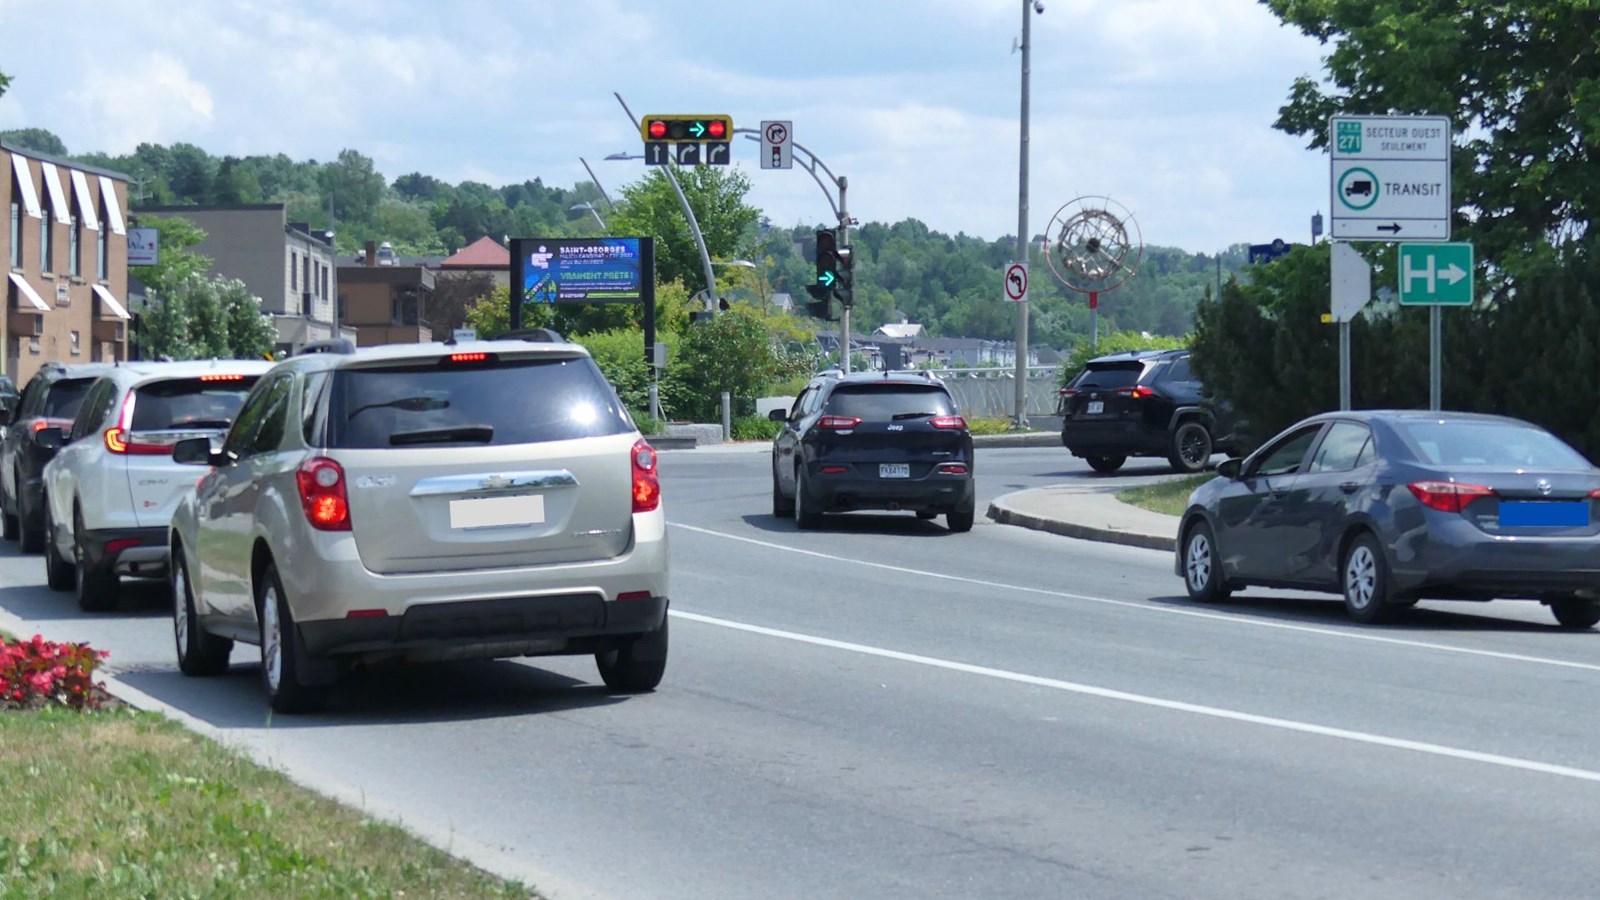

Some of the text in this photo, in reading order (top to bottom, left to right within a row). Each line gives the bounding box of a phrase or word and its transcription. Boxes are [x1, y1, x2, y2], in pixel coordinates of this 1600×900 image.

[1366, 127, 1441, 138] SECTEUR OUEST
[1339, 135, 1361, 149] 271
[1381, 142, 1427, 151] SEULEMENT
[1384, 182, 1442, 196] TRANSIT
[560, 246, 625, 254] SAINT-GEORGES
[560, 272, 602, 280] VRAIMENT
[1403, 254, 1435, 293] H
[887, 424, 904, 432] Jeep
